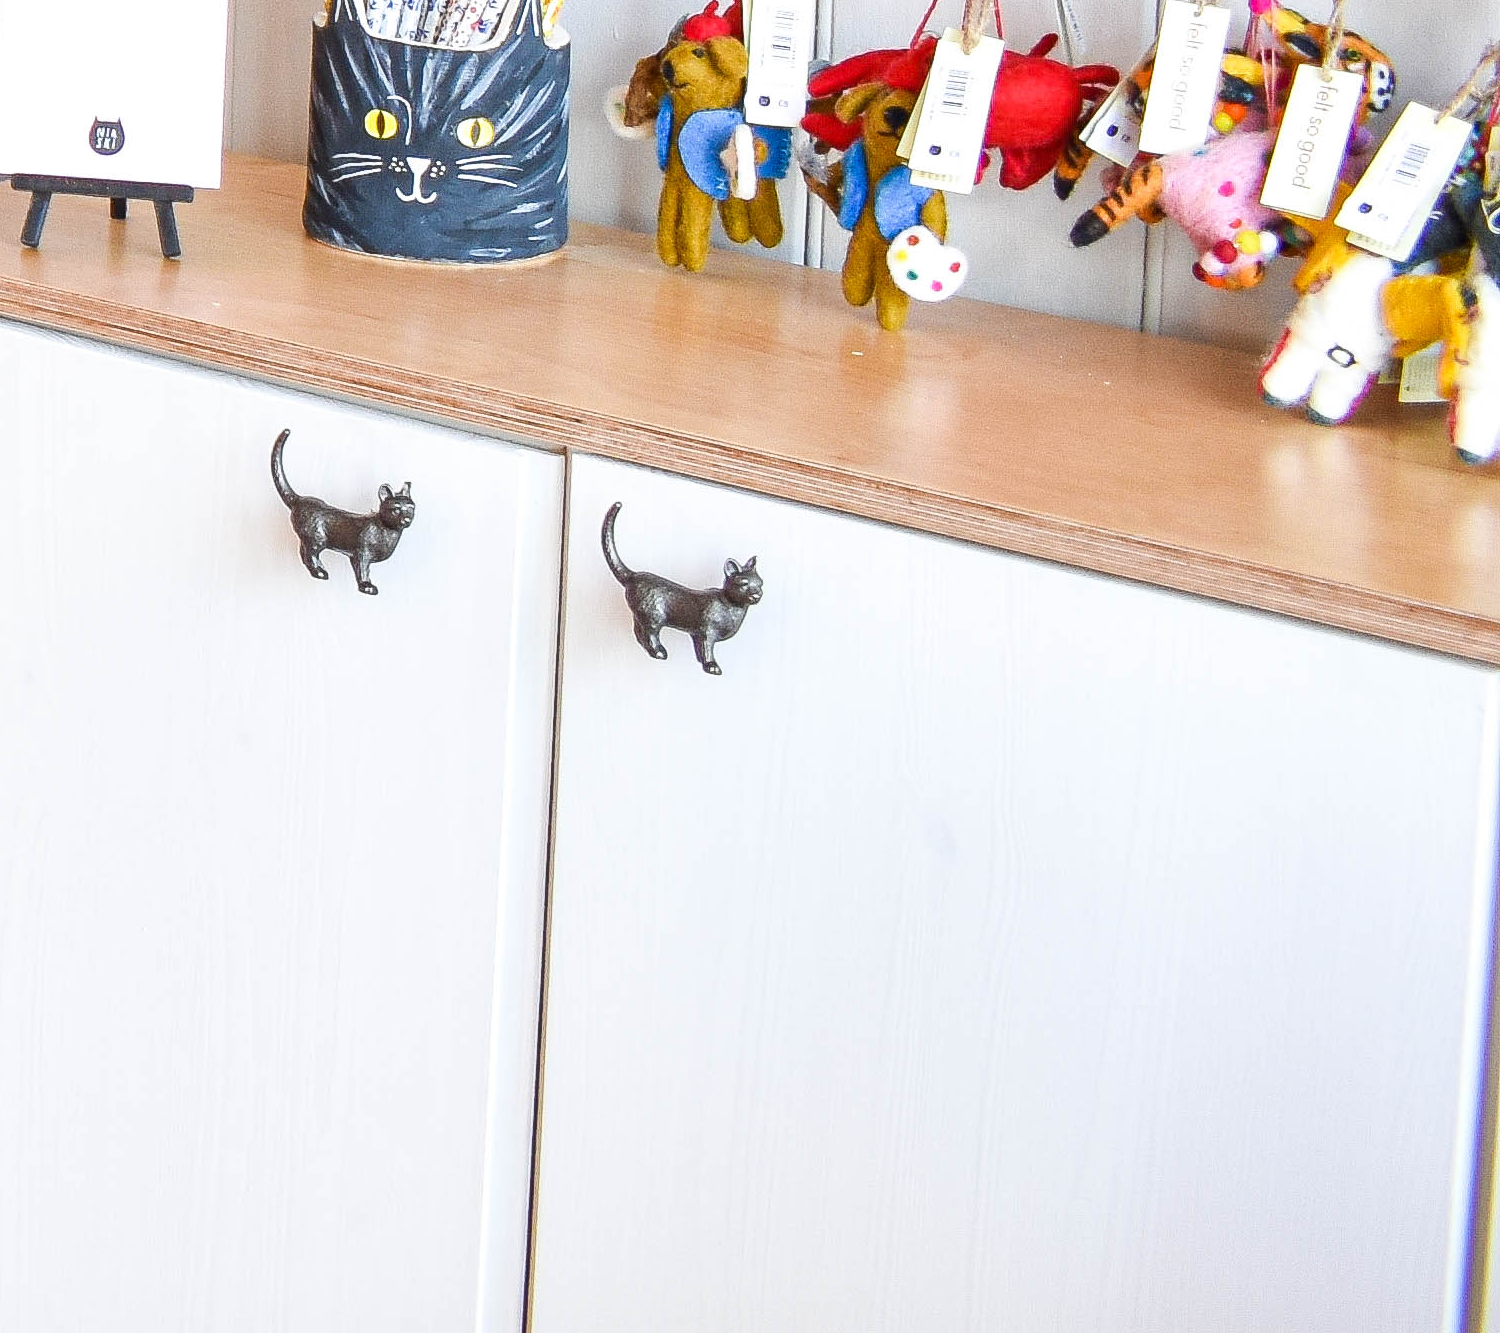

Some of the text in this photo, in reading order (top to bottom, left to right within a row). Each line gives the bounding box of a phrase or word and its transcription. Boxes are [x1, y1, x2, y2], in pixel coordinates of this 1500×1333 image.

[1168, 21, 1208, 132] felt so good
[95, 137, 117, 150] SKI
[96, 126, 118, 138] NIA
[1291, 83, 1339, 190] felt so good
